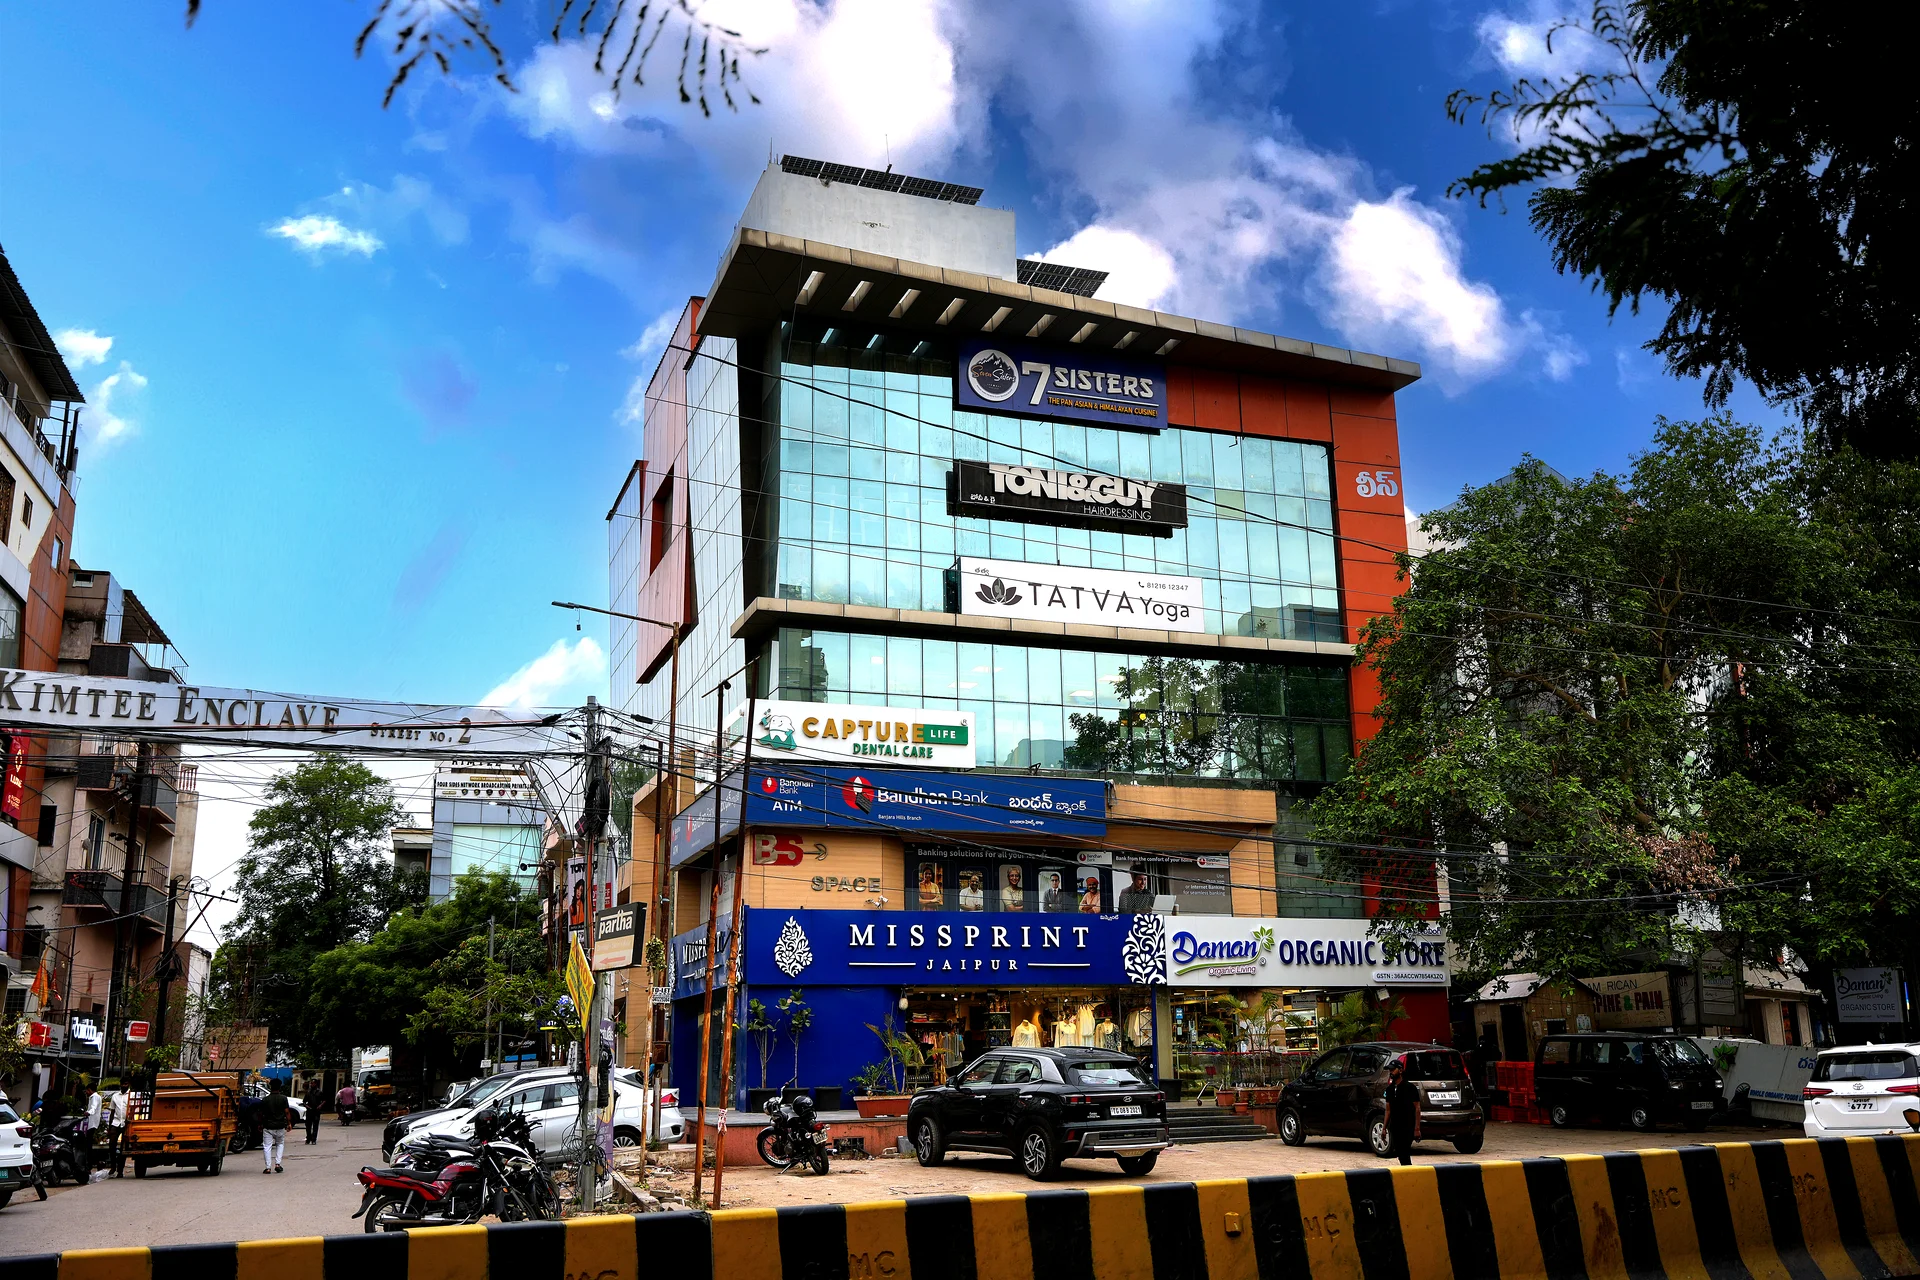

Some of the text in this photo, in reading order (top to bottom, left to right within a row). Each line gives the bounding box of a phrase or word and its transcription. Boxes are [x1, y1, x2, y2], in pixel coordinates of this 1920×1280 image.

[1021, 361, 1154, 405] 7 SISTERS
[1048, 396, 1060, 405] THE
[1060, 398, 1073, 406] PAN
[1074, 400, 1093, 409] ASIAN
[1099, 403, 1133, 414] HIMALAYAN
[989, 463, 1158, 509] TONI&GUY
[1083, 504, 1152, 521] HAIRDRESSING
[1146, 581, 1189, 592] 81216 12347
[1028, 582, 1190, 622] TATVA Yoga
[0, 671, 341, 734] KIMTEE ENCLAVE
[371, 722, 421, 741] STREET
[458, 717, 472, 743] 2
[802, 717, 957, 744] CAPTURE LIFE
[853, 743, 933, 759] DENTAL CARE
[780, 786, 798, 794] Bank
[878, 786, 989, 807] Bandhan Bank
[773, 800, 802, 812] ATM
[918, 849, 948, 858] Banking
[950, 850, 984, 858] solutions
[985, 850, 996, 858] for
[811, 876, 881, 893] SPACE
[598, 909, 634, 940] partha
[849, 924, 1089, 949] MISSPRINT
[1172, 931, 1257, 965] Daman
[1279, 939, 1377, 966] ORGANIC
[926, 959, 1018, 971] JAIPUR
[1208, 966, 1256, 977] Organic Living
[1837, 976, 1883, 995] Daman
[1623, 995, 1632, 1011] &
[1634, 990, 1663, 1011] PAIN
[1841, 1003, 1896, 1011] ORGANIC STORE
[1130, 1106, 1141, 1114] 2021
